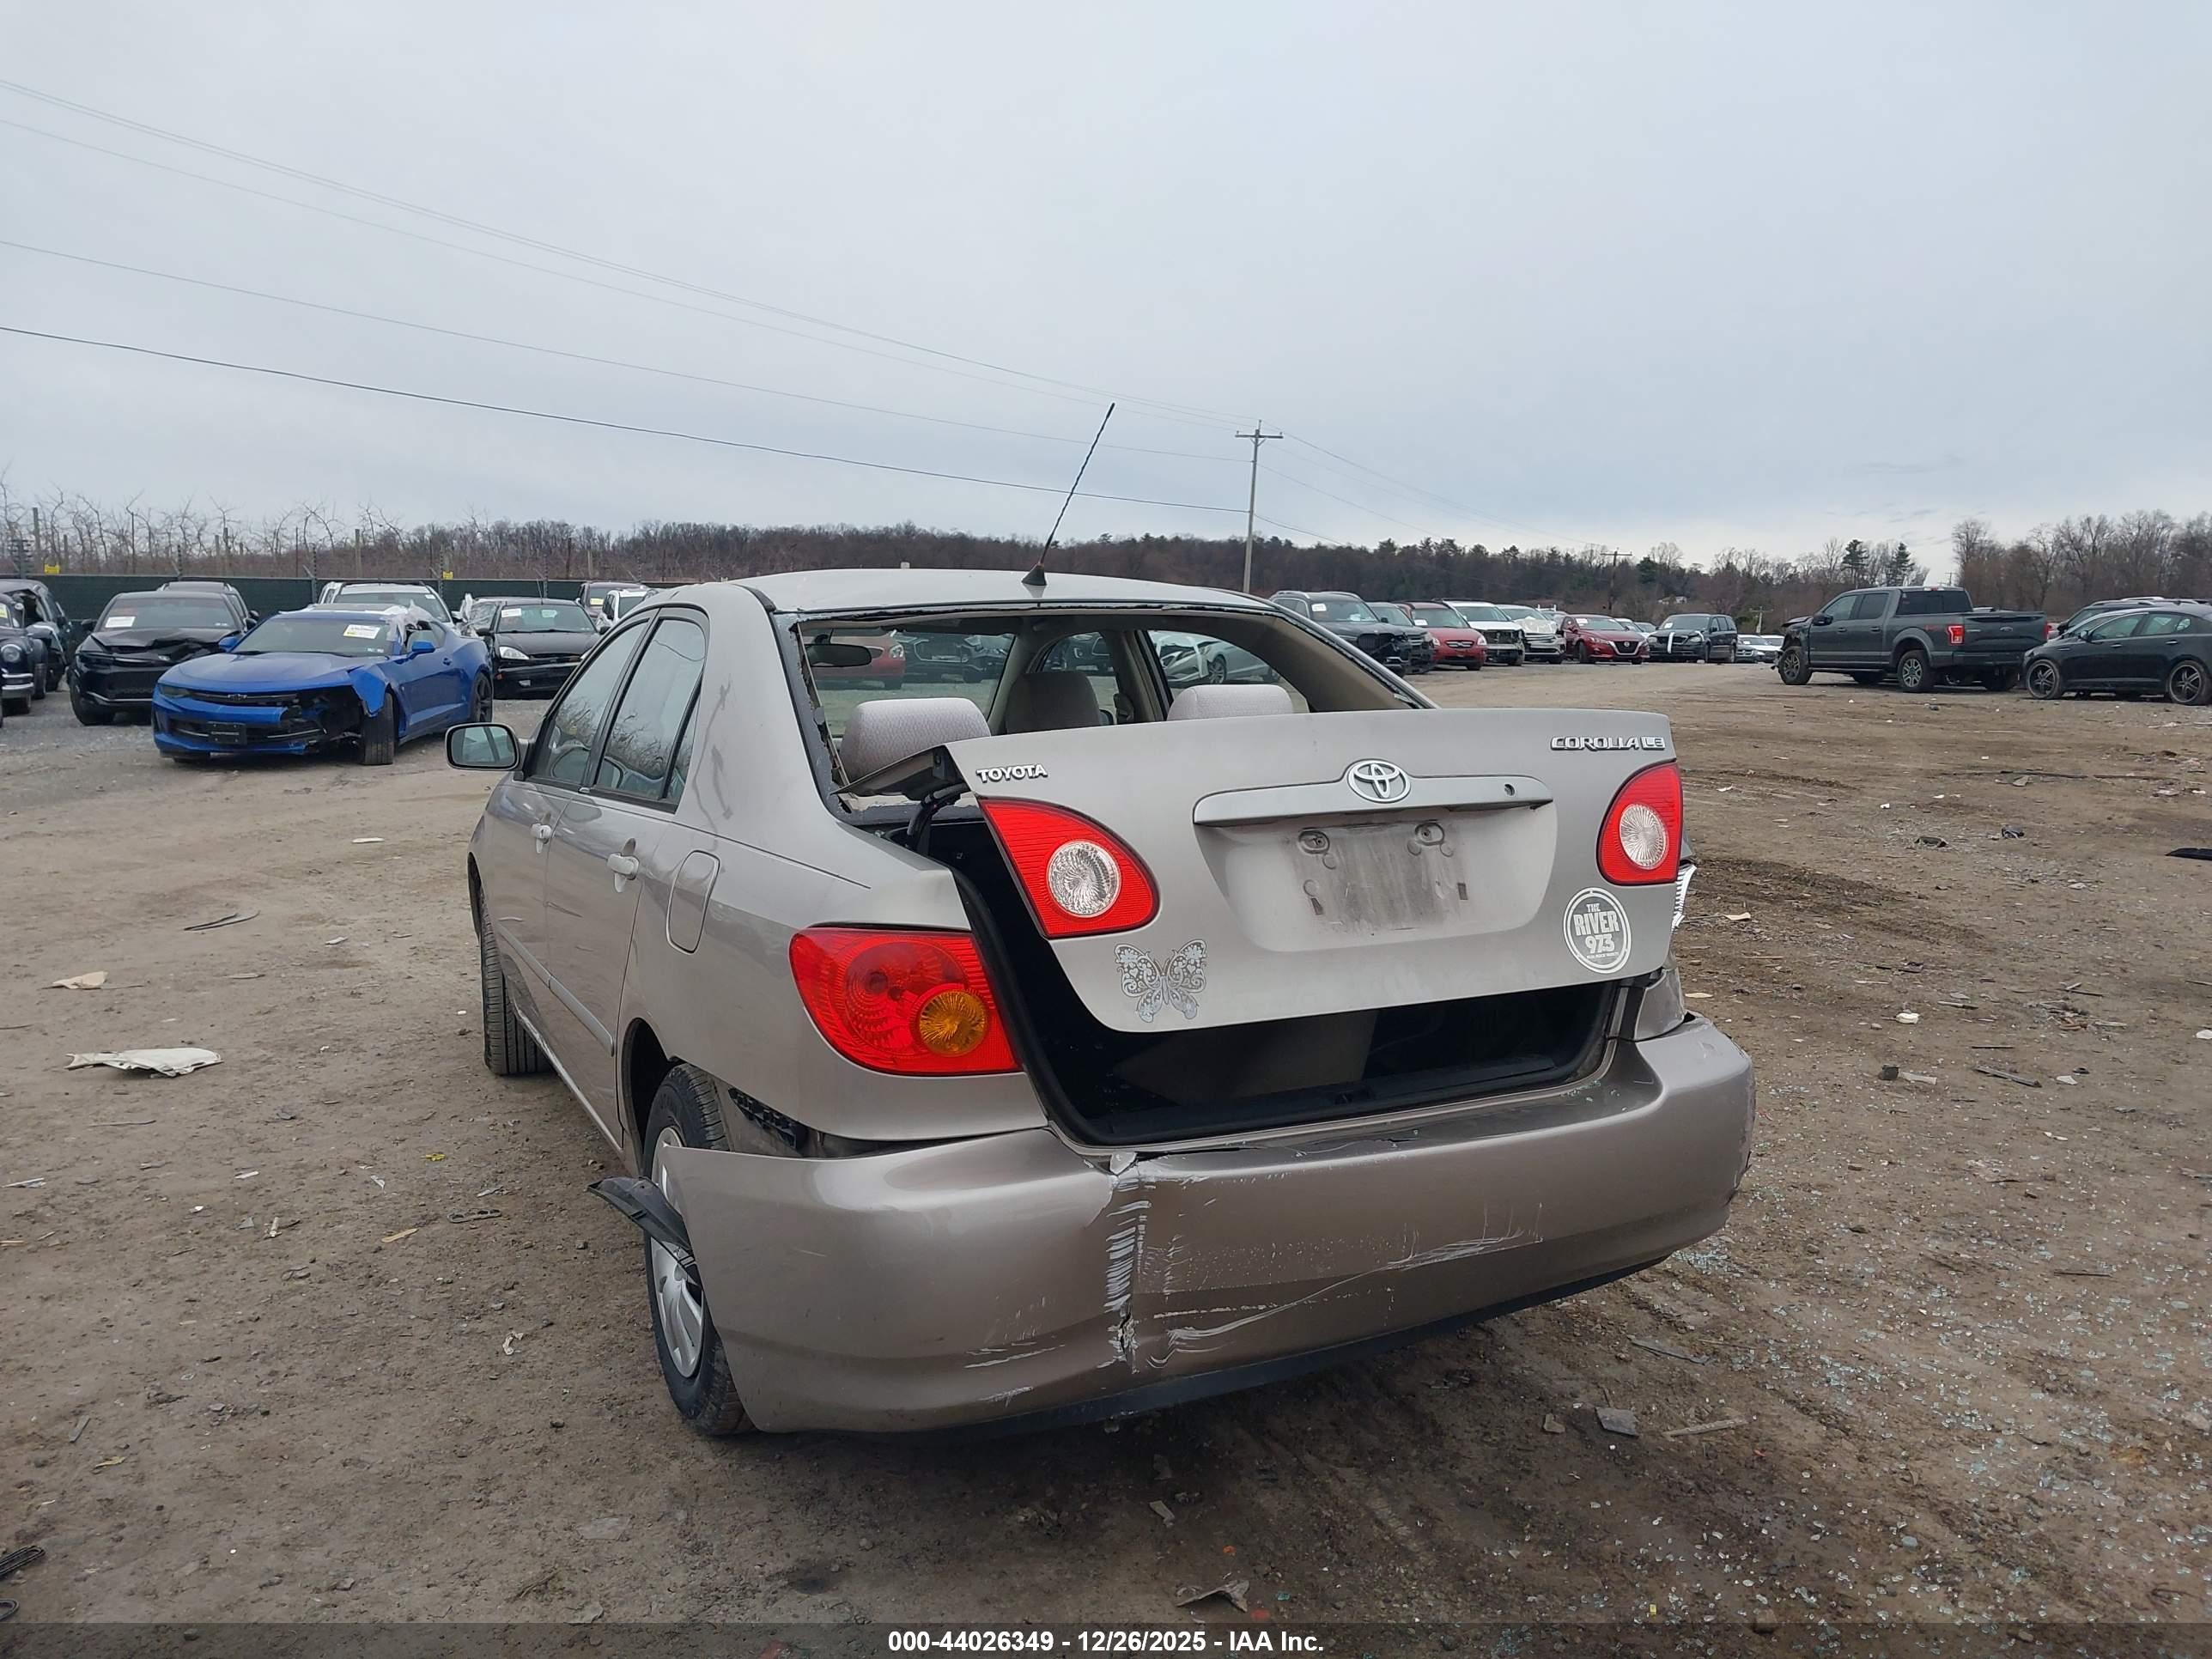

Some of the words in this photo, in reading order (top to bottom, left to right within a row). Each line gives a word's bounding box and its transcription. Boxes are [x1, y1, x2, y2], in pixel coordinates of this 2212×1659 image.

[1551, 736, 1639, 751] COROLLA
[1640, 736, 1666, 750] LE
[975, 763, 1048, 783] TOYOTA
[1586, 902, 1601, 913] THE
[1573, 910, 1620, 936] RIVER
